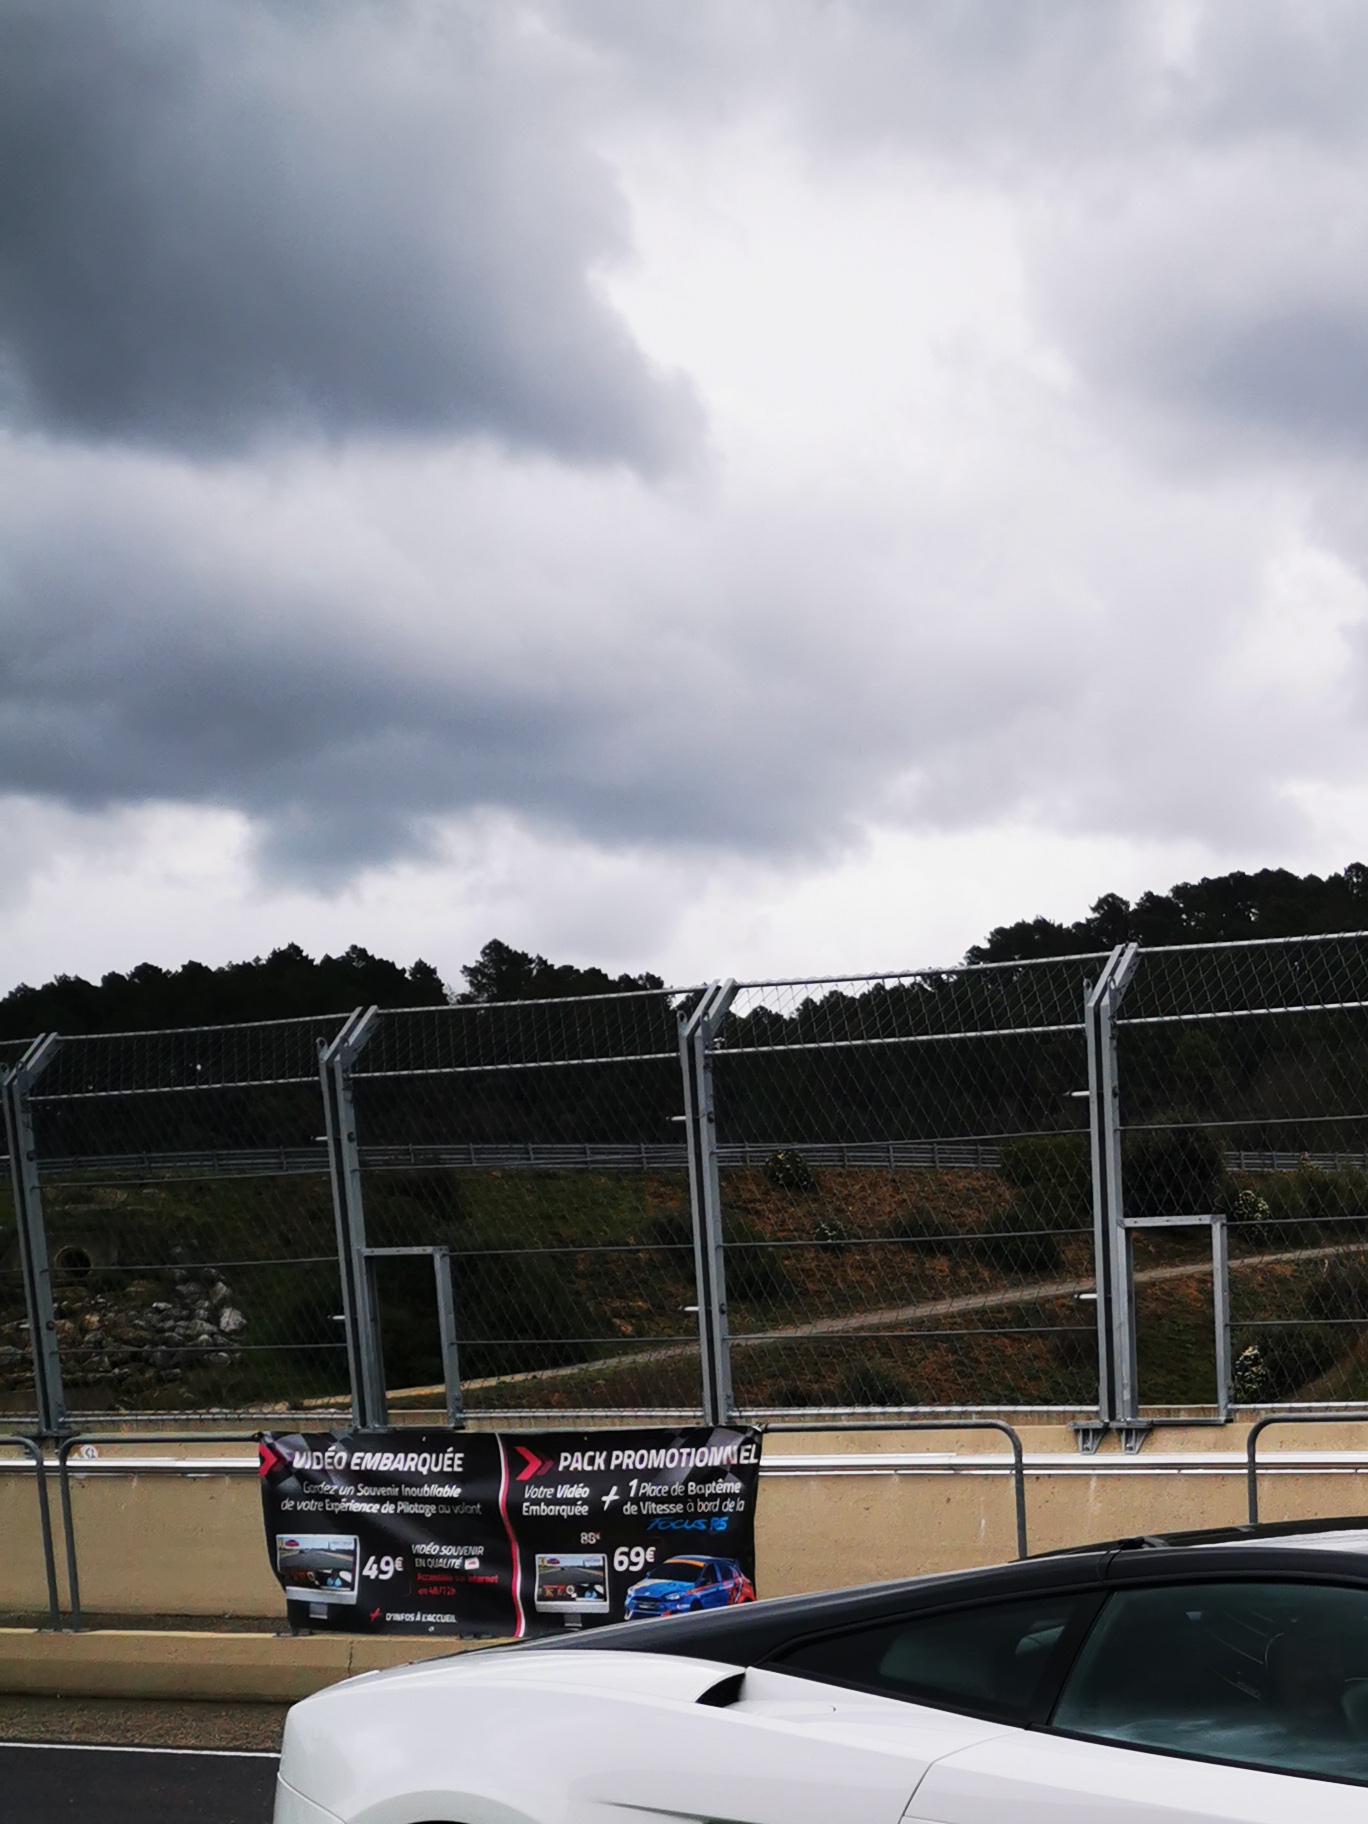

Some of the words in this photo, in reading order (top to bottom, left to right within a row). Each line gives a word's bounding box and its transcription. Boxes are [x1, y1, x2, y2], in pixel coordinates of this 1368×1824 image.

[292, 1445, 346, 1470] VIDÉO
[351, 1446, 465, 1475] EMBARQUÉE
[558, 1451, 606, 1471] PACK
[610, 1443, 759, 1470] PROMOTIONNEL
[338, 1484, 355, 1496] un
[356, 1481, 399, 1497] Souvenir
[401, 1482, 462, 1498] Inoubliable
[524, 1484, 555, 1499] Votre
[556, 1483, 590, 1499] Vidéo
[628, 1478, 639, 1498] 1
[639, 1482, 668, 1497] Place
[670, 1482, 686, 1496] de
[687, 1478, 742, 1497] Baptême
[281, 1498, 294, 1511] de
[296, 1499, 324, 1511] votre
[325, 1498, 380, 1514] Expérience
[380, 1501, 395, 1514] de
[396, 1502, 437, 1517] Pilotage
[522, 1501, 589, 1519] Embarquée
[622, 1501, 638, 1515] de
[640, 1501, 684, 1515] Vitesse
[686, 1500, 695, 1513] à
[697, 1499, 720, 1513] bord
[721, 1499, 735, 1513] de
[411, 1541, 440, 1555] VIDÉO
[440, 1545, 484, 1556] SOUVENIR
[362, 1556, 404, 1580] 49€
[613, 1546, 656, 1572] 69€
